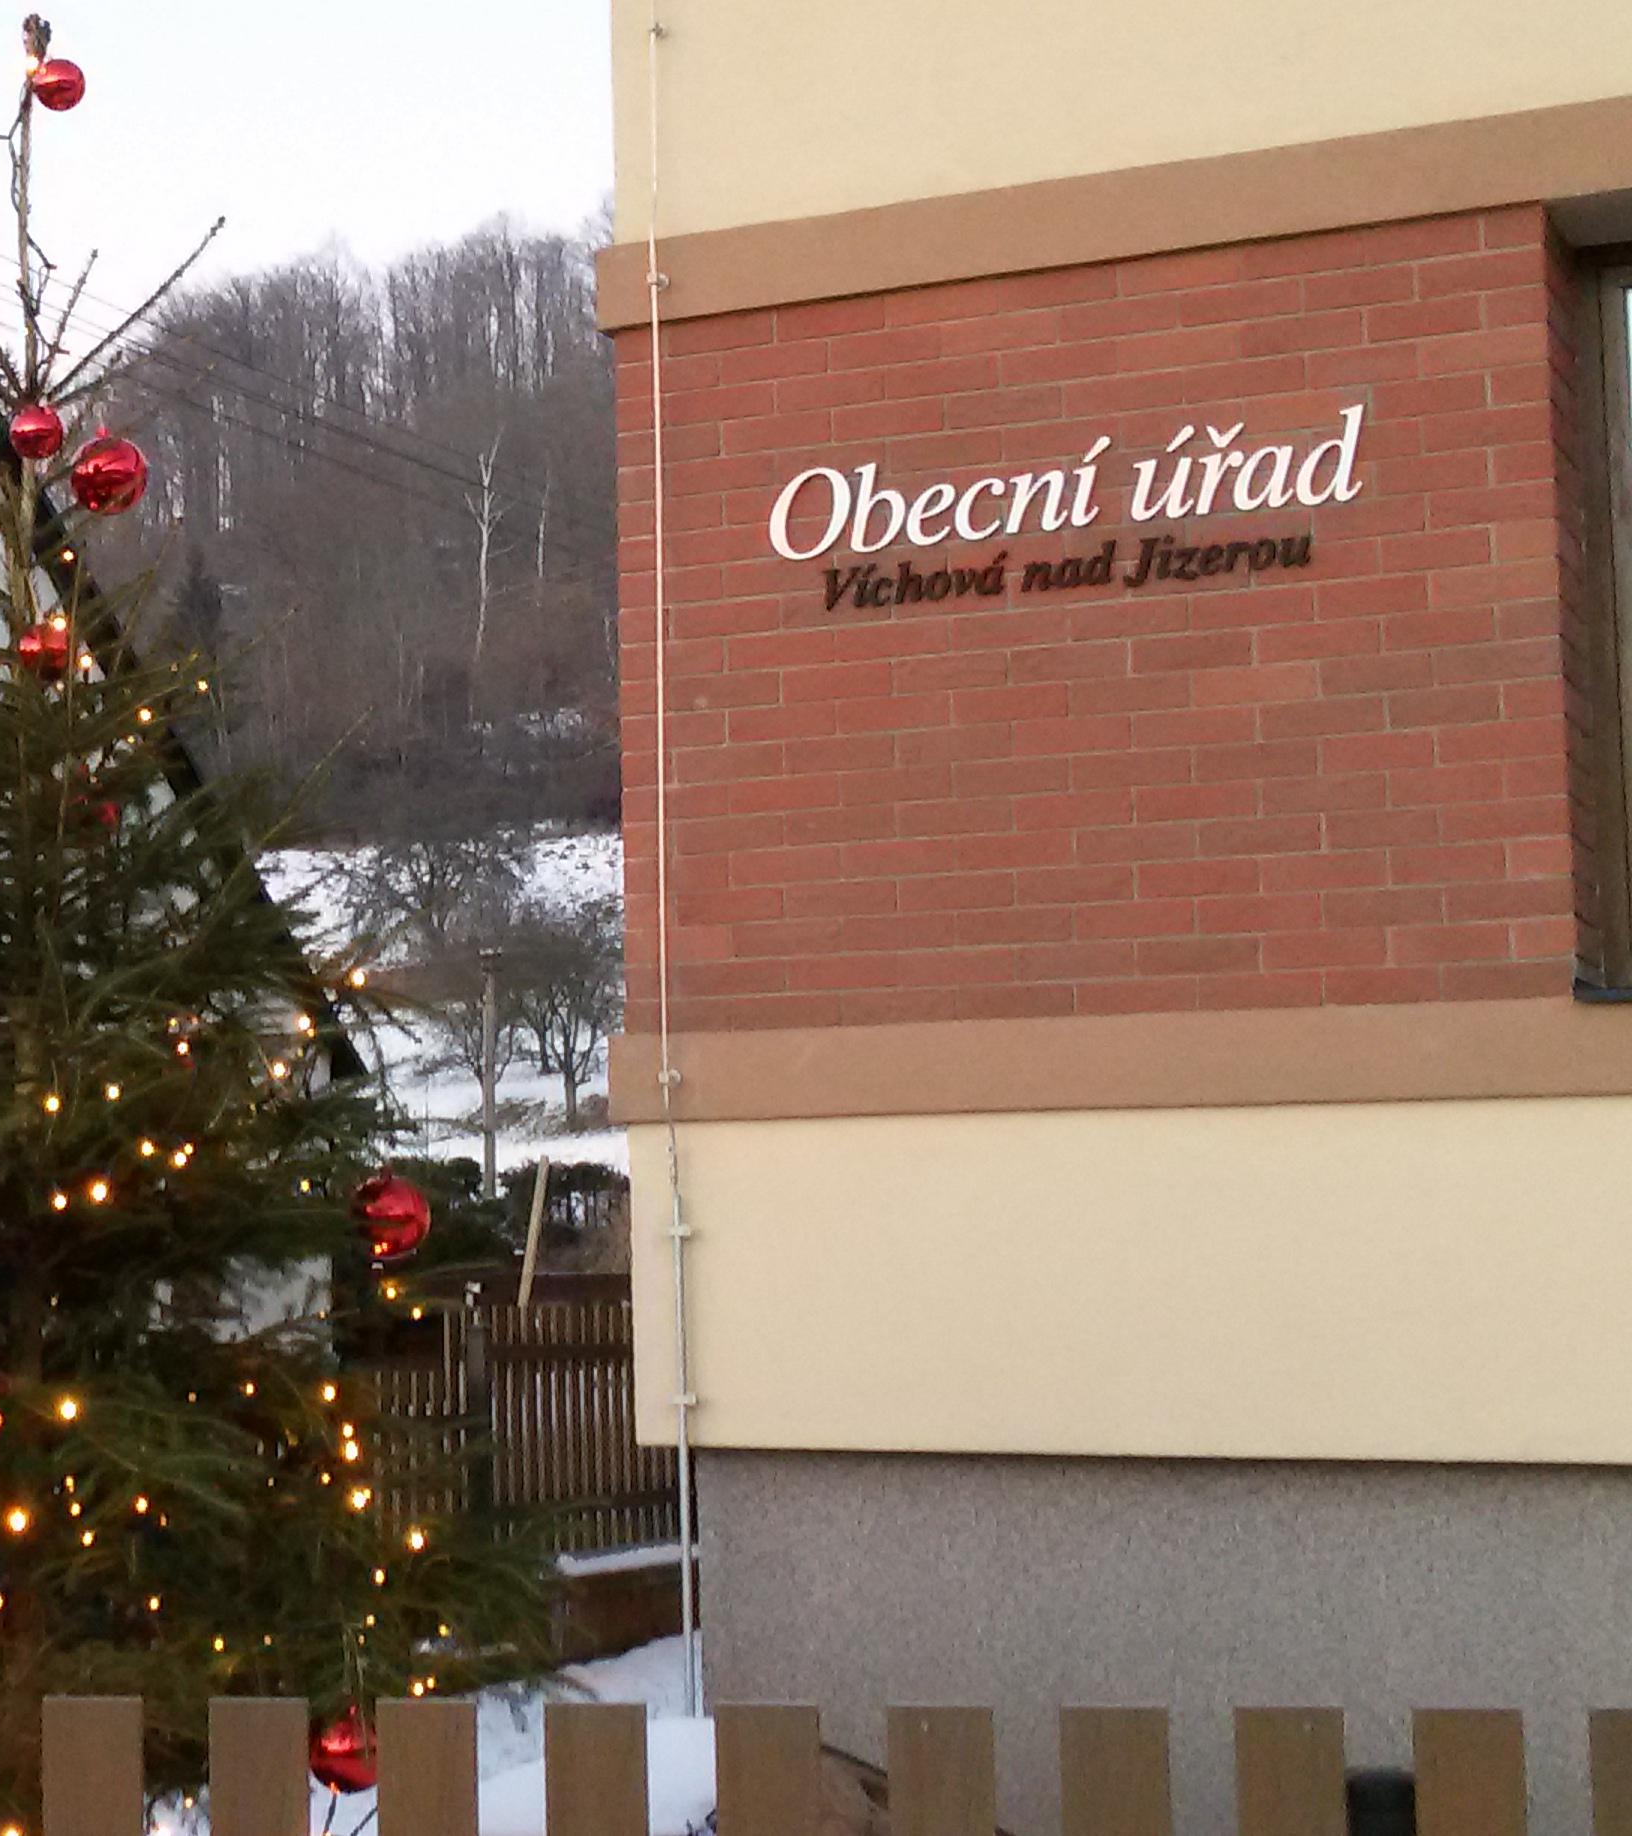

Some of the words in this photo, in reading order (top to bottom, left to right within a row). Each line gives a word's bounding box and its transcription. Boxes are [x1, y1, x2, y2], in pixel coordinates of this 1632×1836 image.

[767, 435, 1111, 562] Obecní
[1129, 403, 1368, 523] úřad
[821, 550, 1009, 612] Víchová
[1020, 539, 1117, 593] nad
[1122, 533, 1313, 588] Jizerou
